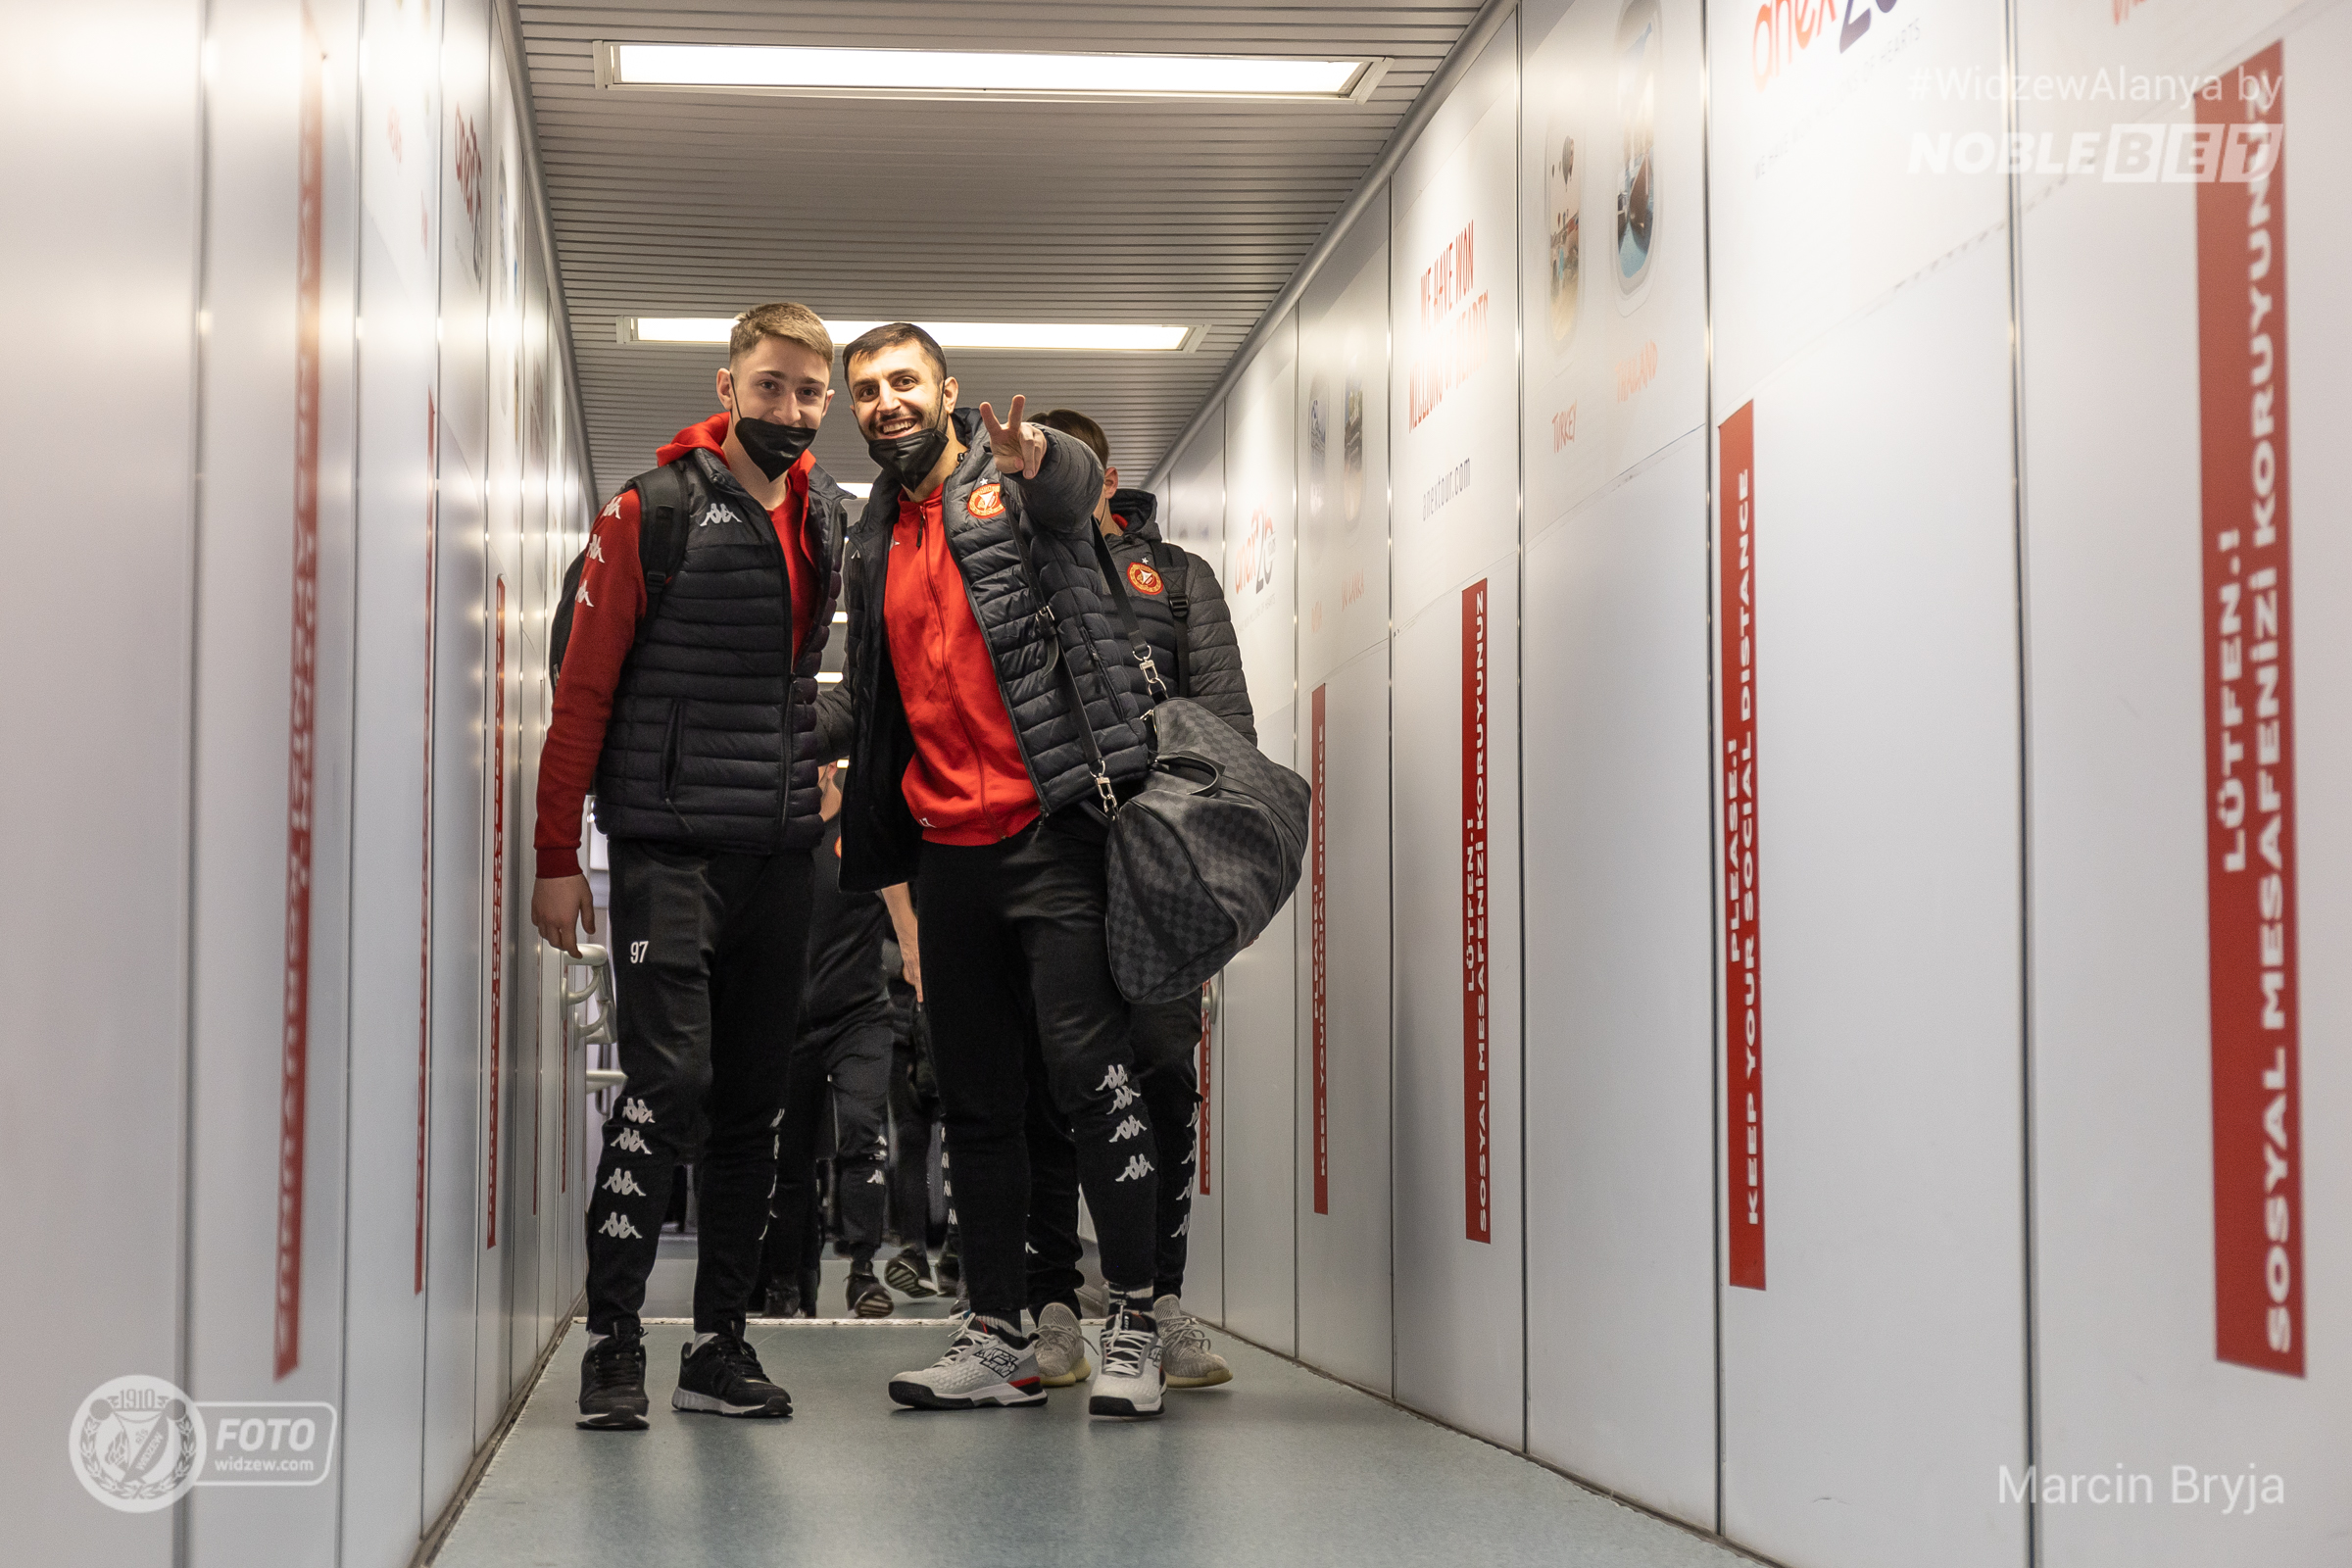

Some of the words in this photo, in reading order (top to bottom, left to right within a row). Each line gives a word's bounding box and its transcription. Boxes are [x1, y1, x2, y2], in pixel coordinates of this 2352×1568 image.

[1455, 219, 1474, 304] WON
[1422, 457, 1471, 522] anextour.com
[1738, 468, 1752, 722] DISTANCE
[1476, 590, 1485, 830] KORUYUNUZ
[1740, 730, 1754, 923] SOCIAL
[629, 940, 650, 964] 97
[1744, 936, 1756, 1080] YOUR
[1478, 1080, 1488, 1233] SOSYAL
[1745, 1092, 1759, 1225] KEEP
[2262, 1046, 2292, 1355] SOSYAL
